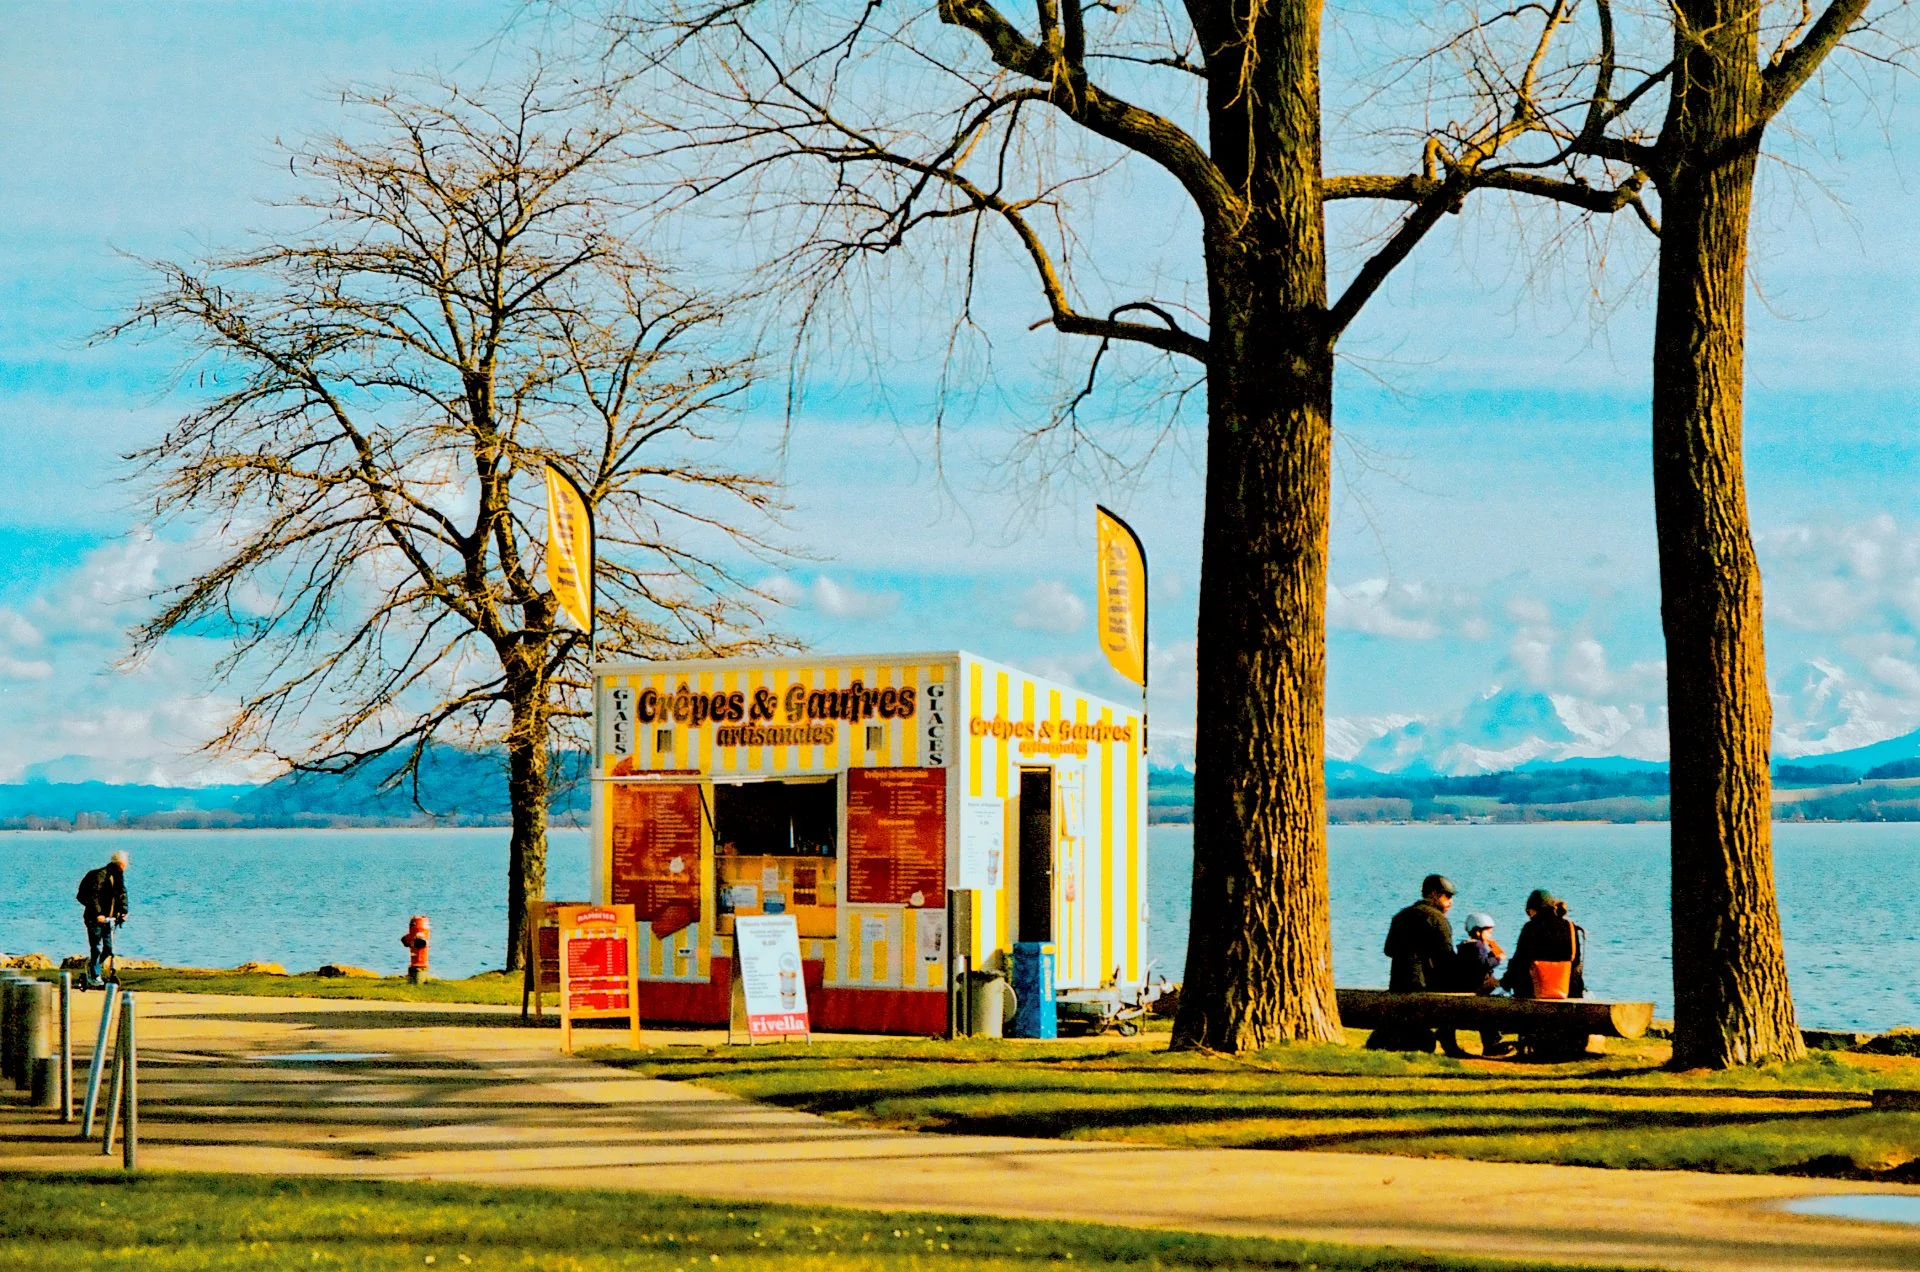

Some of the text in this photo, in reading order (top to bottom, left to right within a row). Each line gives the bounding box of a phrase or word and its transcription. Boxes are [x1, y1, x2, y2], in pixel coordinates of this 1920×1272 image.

[612, 689, 629, 755] GLACES
[637, 679, 918, 729] Crêpes & Gaufres
[715, 722, 835, 748] artisanales
[926, 684, 945, 767] GLACES
[969, 714, 1132, 744] Crêpes & Gaufres
[750, 1015, 806, 1032] rivella
